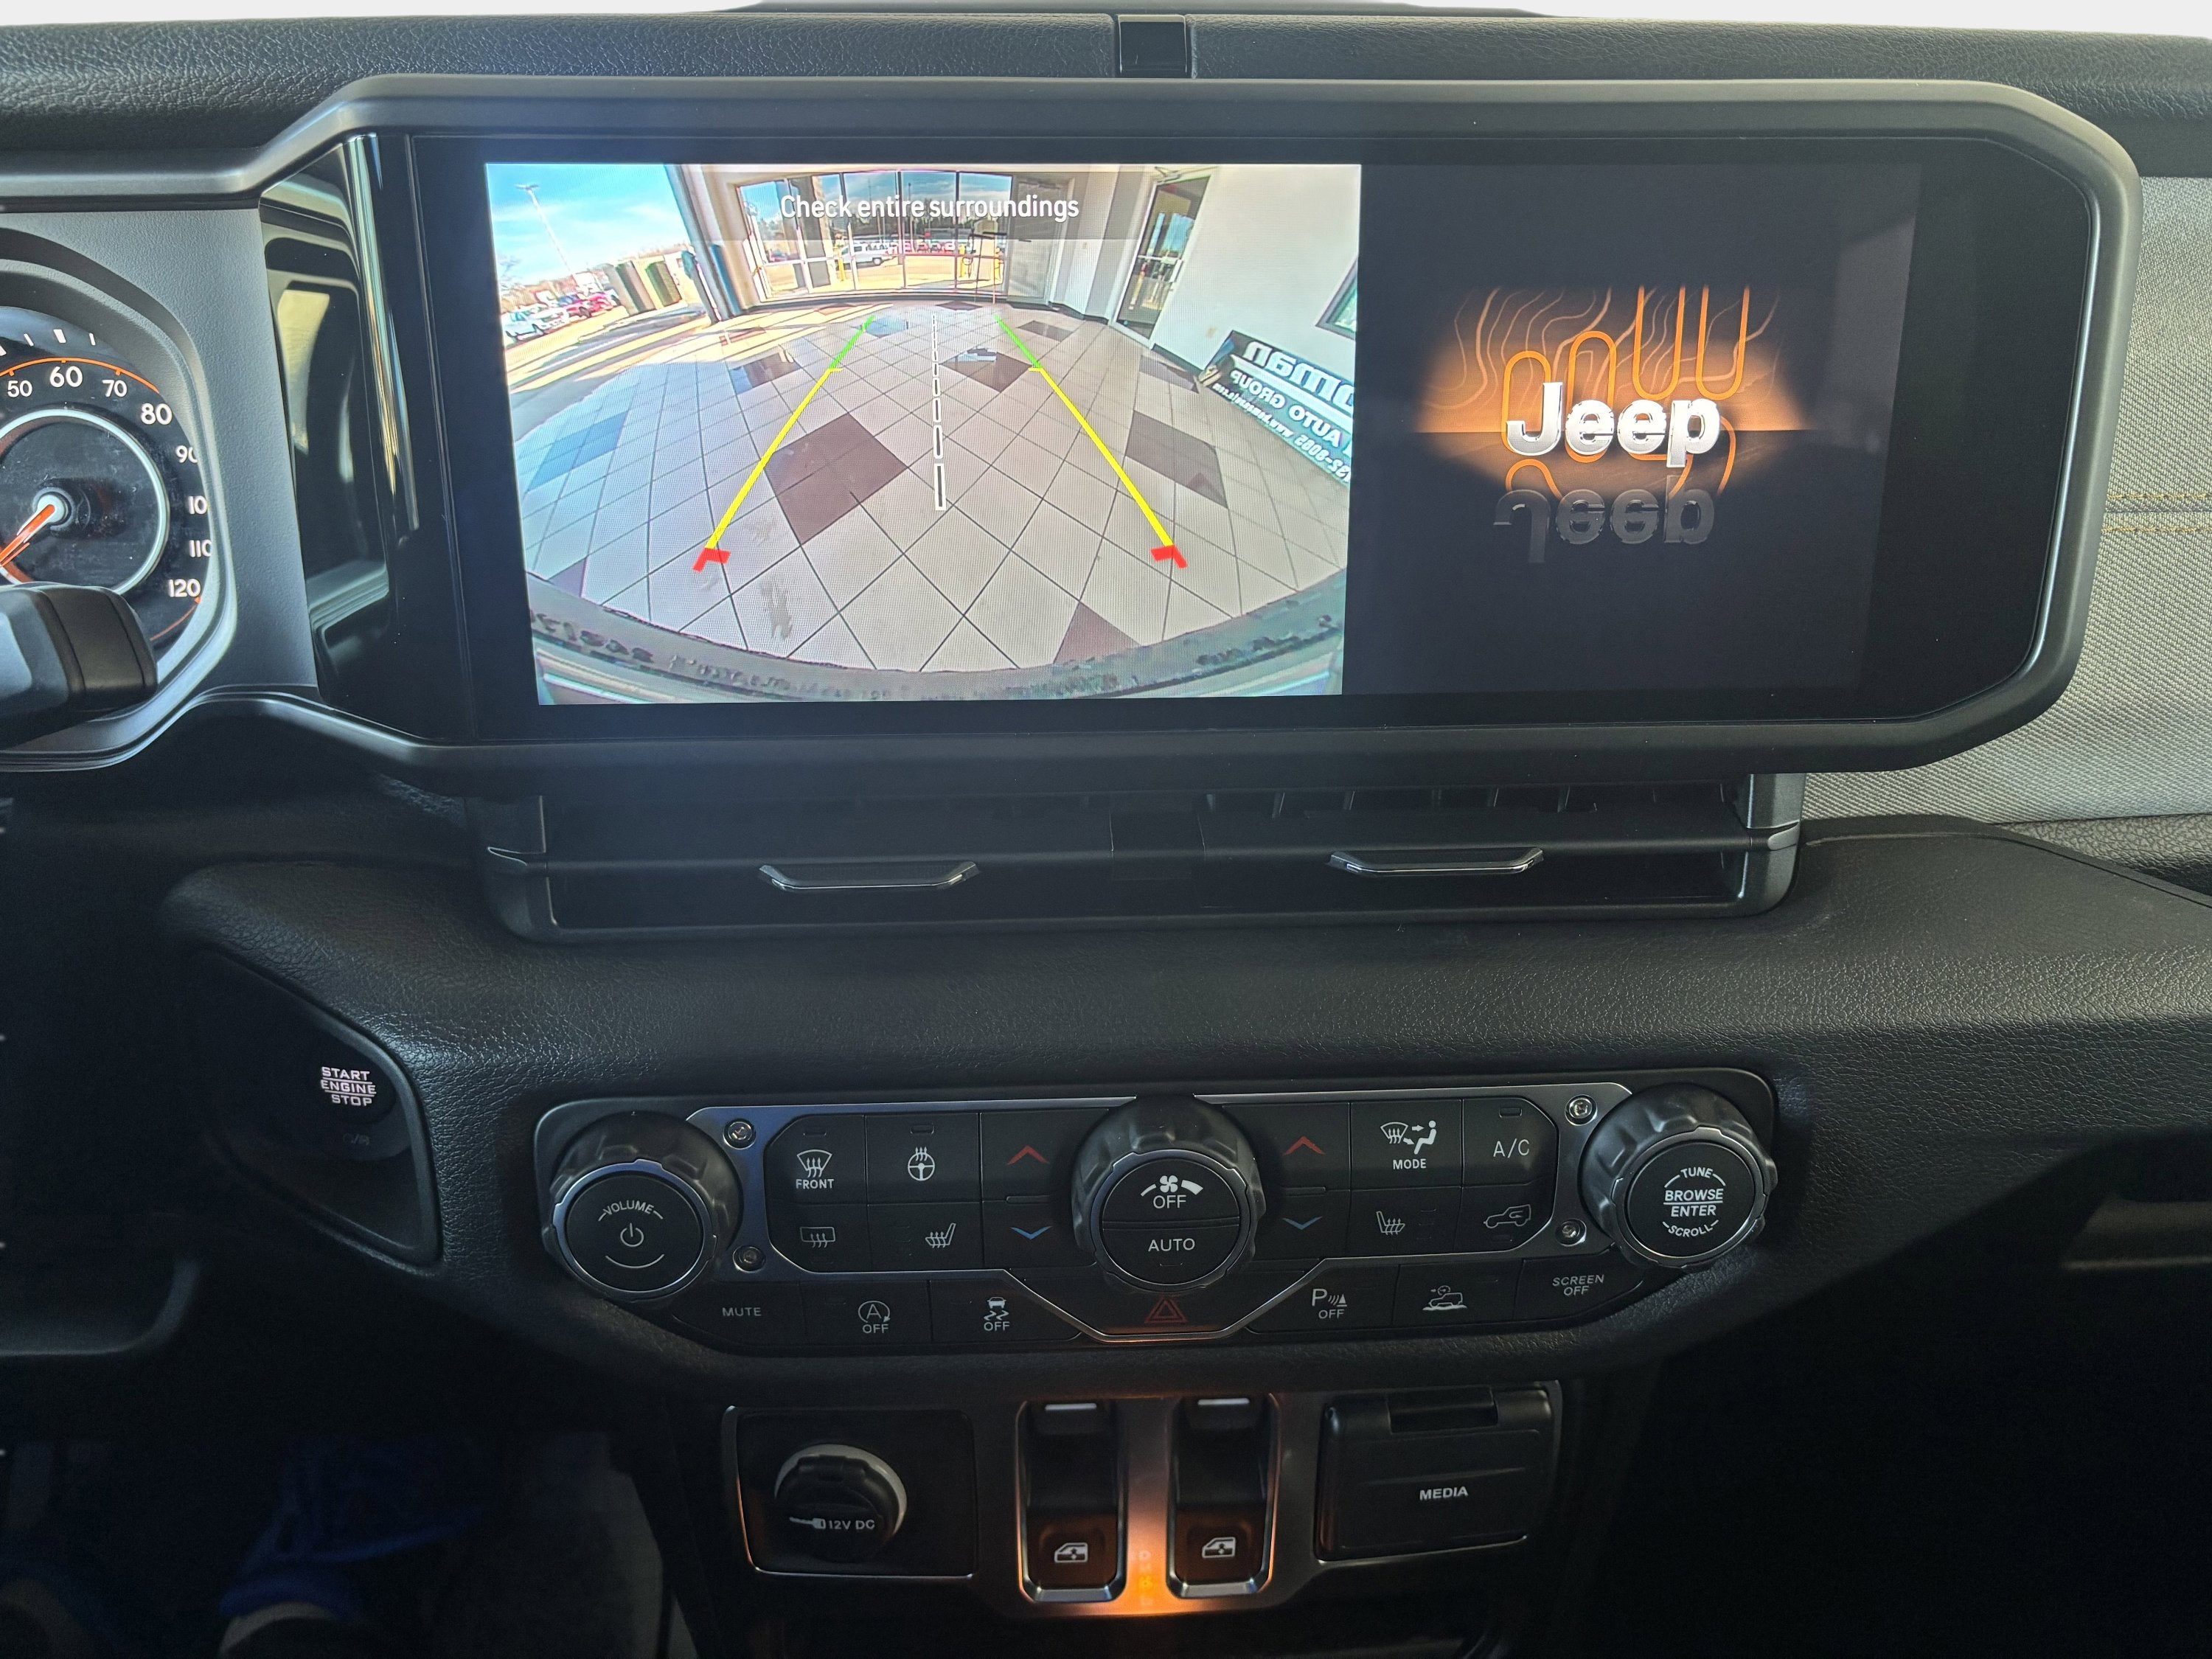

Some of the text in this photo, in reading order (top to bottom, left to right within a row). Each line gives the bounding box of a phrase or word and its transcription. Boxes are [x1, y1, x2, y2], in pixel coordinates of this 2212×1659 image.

[781, 195, 1079, 223] Check entire surroundings
[50, 366, 83, 388] 60
[7, 380, 32, 397] 50
[102, 379, 128, 397] 70
[140, 403, 173, 425] 80
[1506, 381, 1720, 467] Jeep
[168, 579, 201, 598] 120
[321, 1066, 370, 1081] START
[321, 1079, 377, 1095] ENGINE
[331, 1094, 372, 1107] STOP
[1493, 1138, 1530, 1158] A/C
[1393, 1158, 1427, 1170] MODE
[1680, 1166, 1714, 1179] TUNE
[796, 1178, 835, 1189] FRONT
[1152, 1194, 1187, 1209] OFF
[1664, 1188, 1724, 1202] BROWSE
[602, 1200, 655, 1215] VOLUME
[1671, 1204, 1717, 1217] ENTER
[1668, 1224, 1714, 1237] SCROLL
[1148, 1238, 1195, 1252] AUTO
[1552, 1274, 1604, 1287] SCREEN
[1563, 1286, 1589, 1296] OFF
[722, 1307, 762, 1318] MUTE
[1318, 1309, 1344, 1320] OFF
[862, 1324, 889, 1334] OFF
[983, 1321, 1010, 1332] OFF
[1419, 1486, 1469, 1501] MEDIA
[829, 1520, 875, 1530] 12V DC
